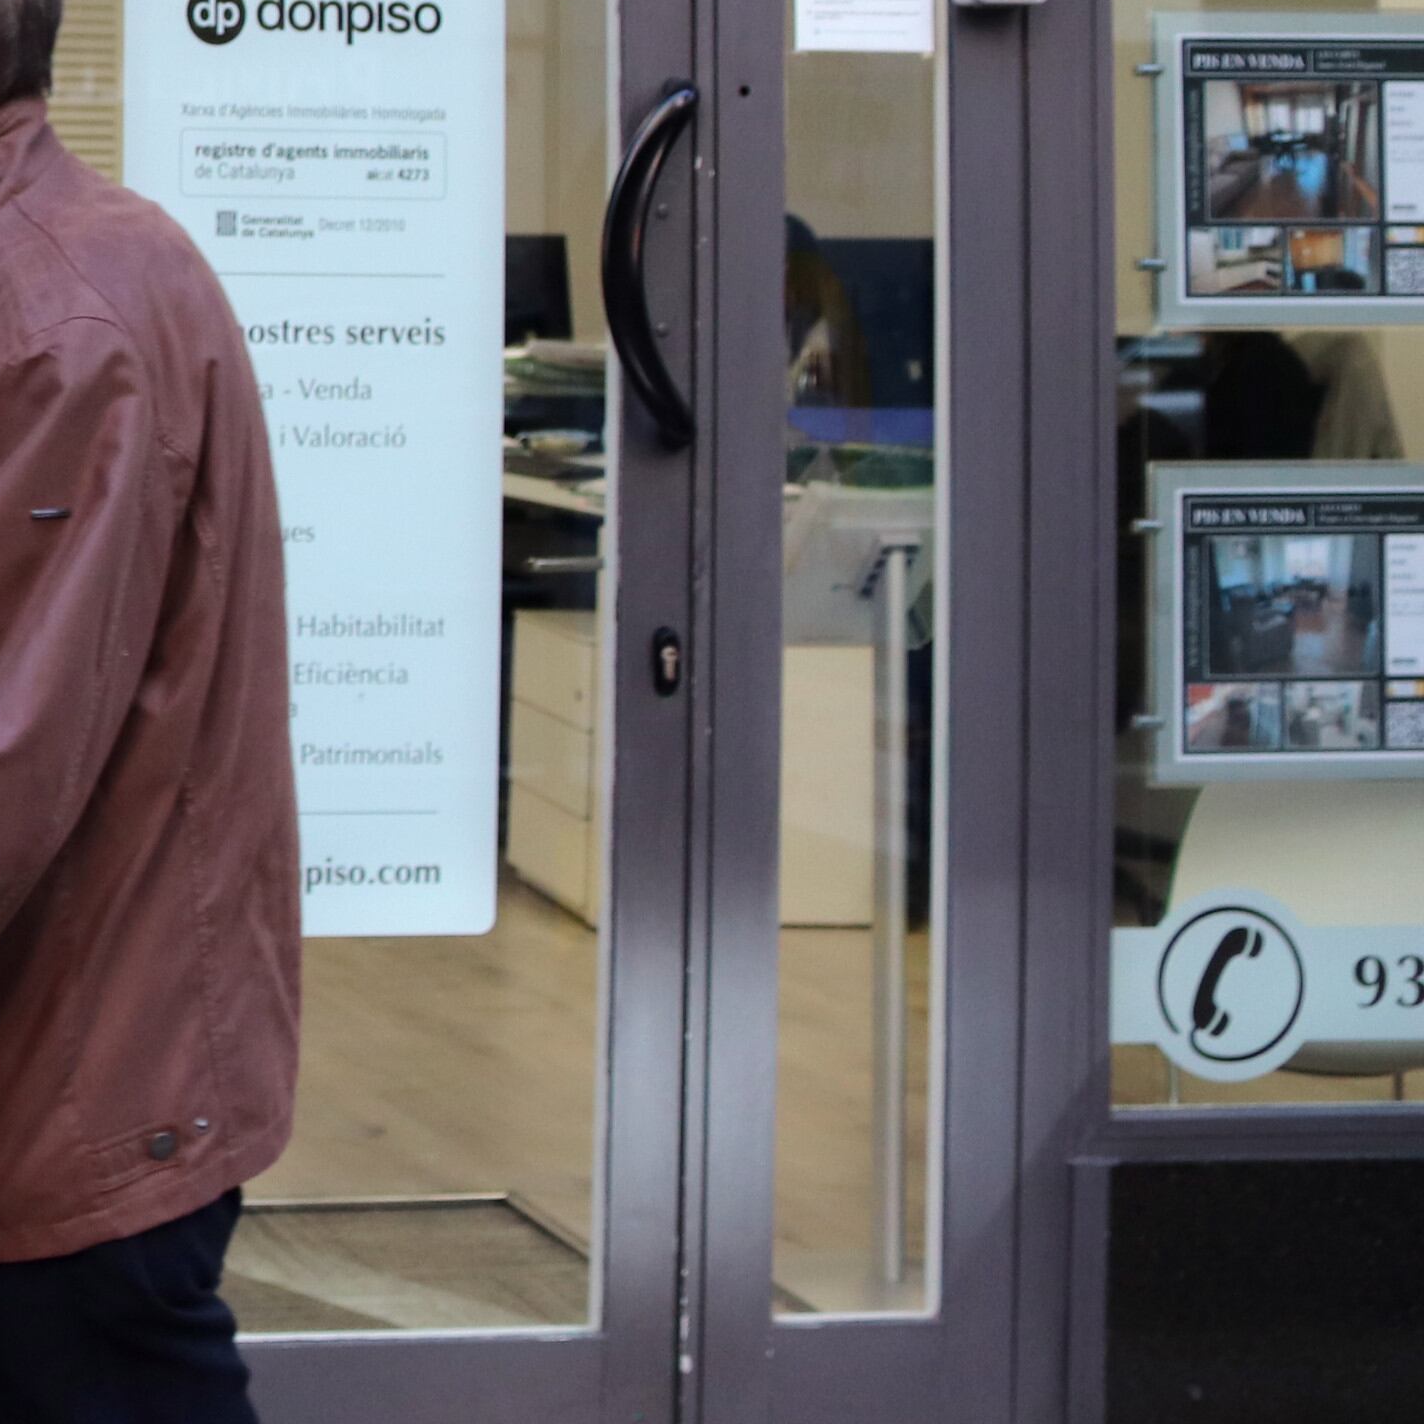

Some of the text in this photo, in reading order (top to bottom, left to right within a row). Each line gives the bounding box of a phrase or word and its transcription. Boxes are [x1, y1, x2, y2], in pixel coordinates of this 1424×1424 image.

[195, 143, 430, 161] registre d'agents immobiliaris
[195, 163, 430, 182] de Catalunya 4273
[242, 214, 304, 226] Generalitat
[259, 227, 315, 241] Catalunya
[248, 317, 446, 345] ostres serveis
[298, 377, 373, 400] Venda
[293, 425, 406, 448] Valoració
[296, 615, 445, 638] Habitabilitat
[293, 662, 408, 685] Eficiència
[300, 742, 443, 765] Patrimonials
[1355, 954, 1424, 1008] 93
